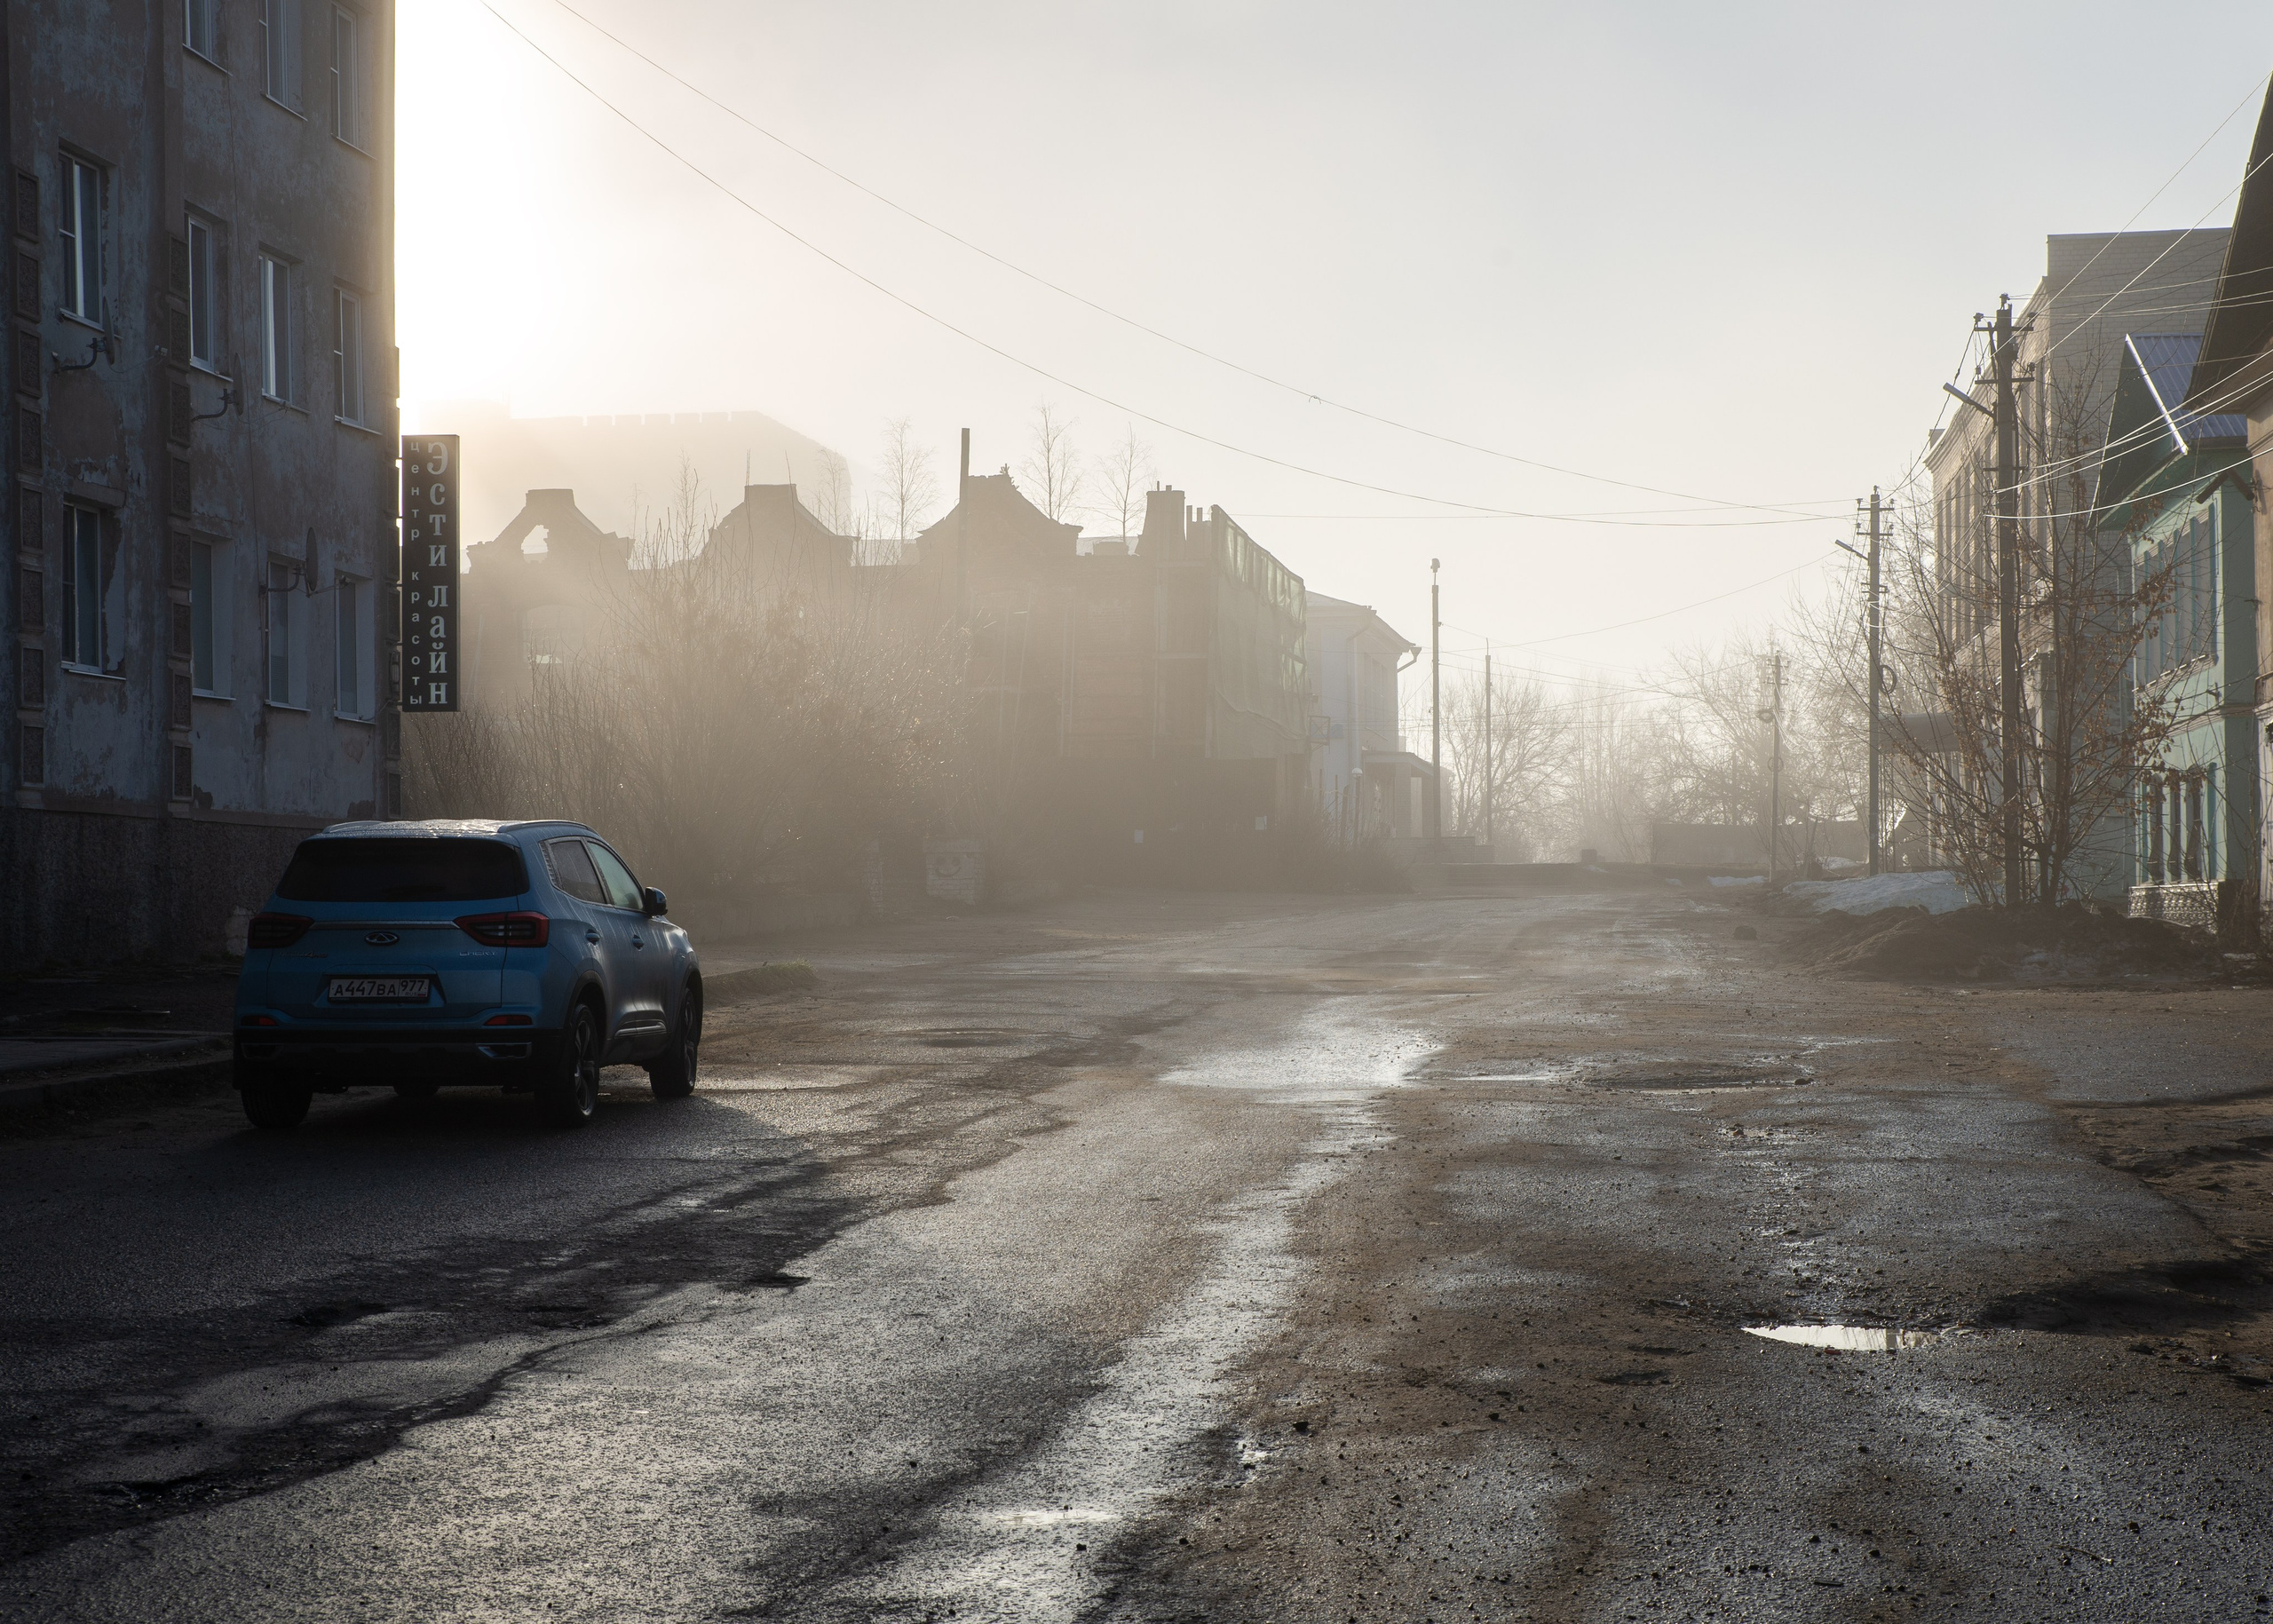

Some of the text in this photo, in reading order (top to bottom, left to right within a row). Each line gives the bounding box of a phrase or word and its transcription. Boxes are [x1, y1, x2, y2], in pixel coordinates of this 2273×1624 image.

[410, 441, 423, 705] центр красоты
[400, 979, 426, 992] 977
